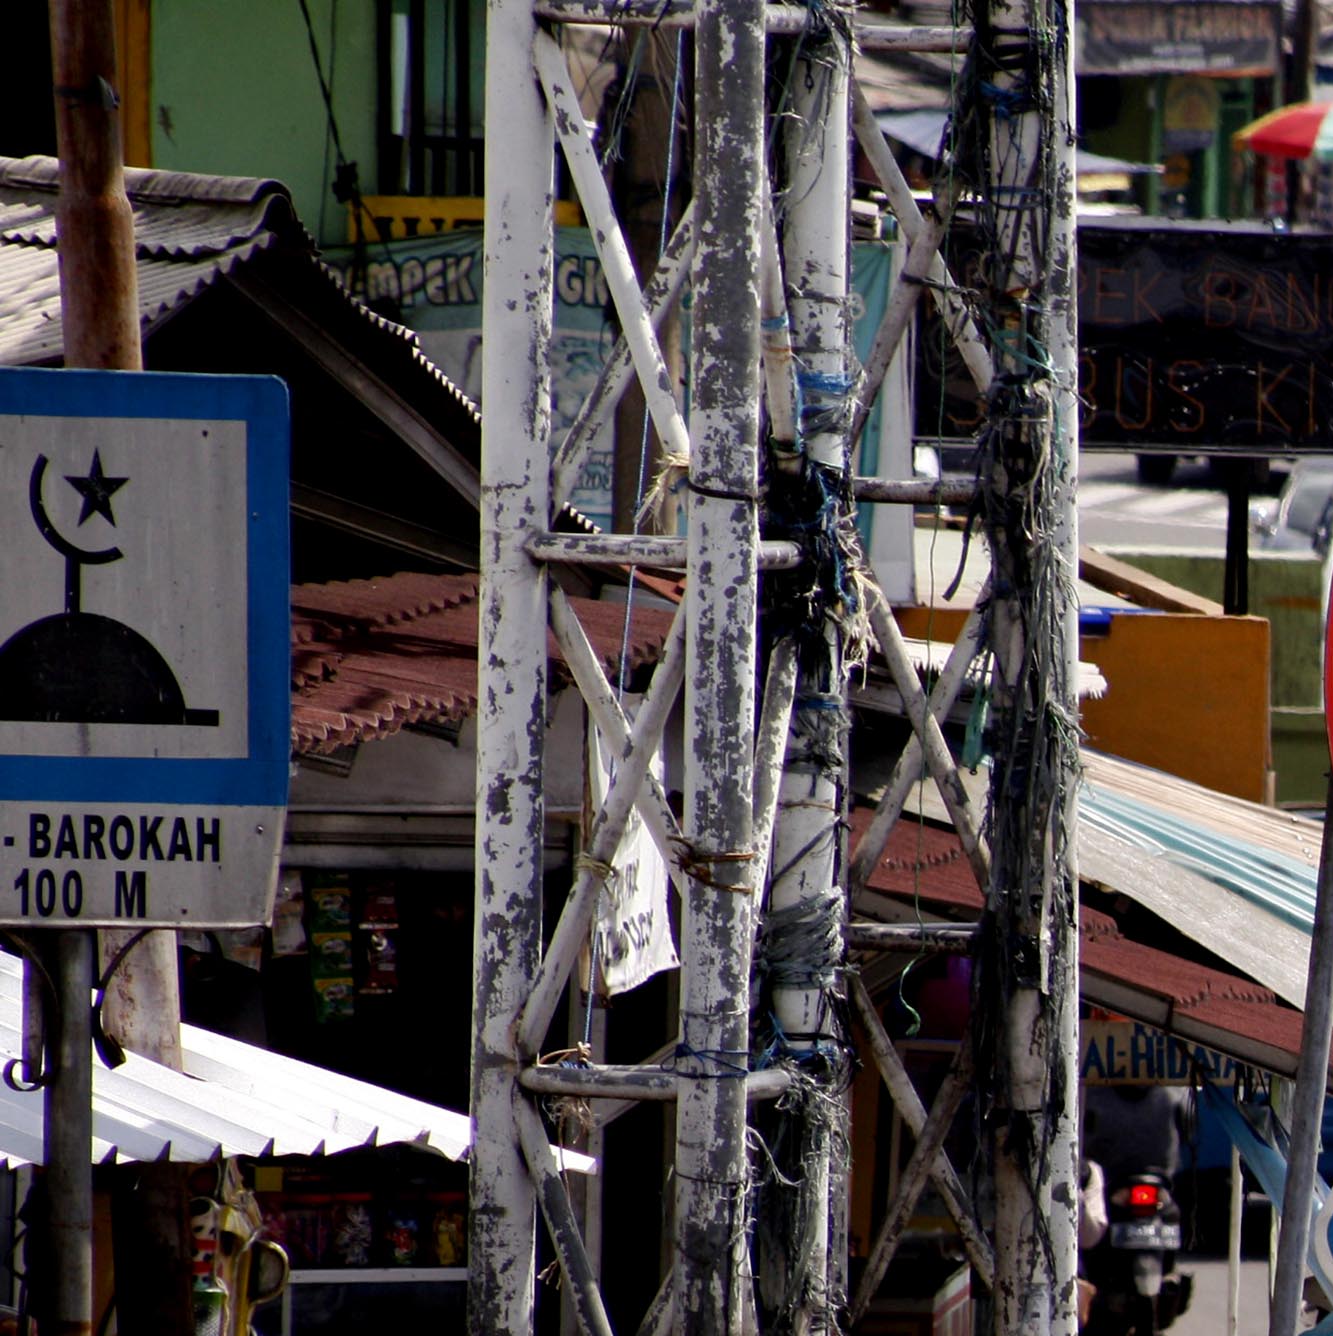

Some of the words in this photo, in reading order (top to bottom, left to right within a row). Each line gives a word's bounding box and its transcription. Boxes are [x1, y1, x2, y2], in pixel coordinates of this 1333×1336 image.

[28, 813, 221, 863] BAROKAH
[14, 867, 84, 918] 100
[114, 870, 147, 918] M
